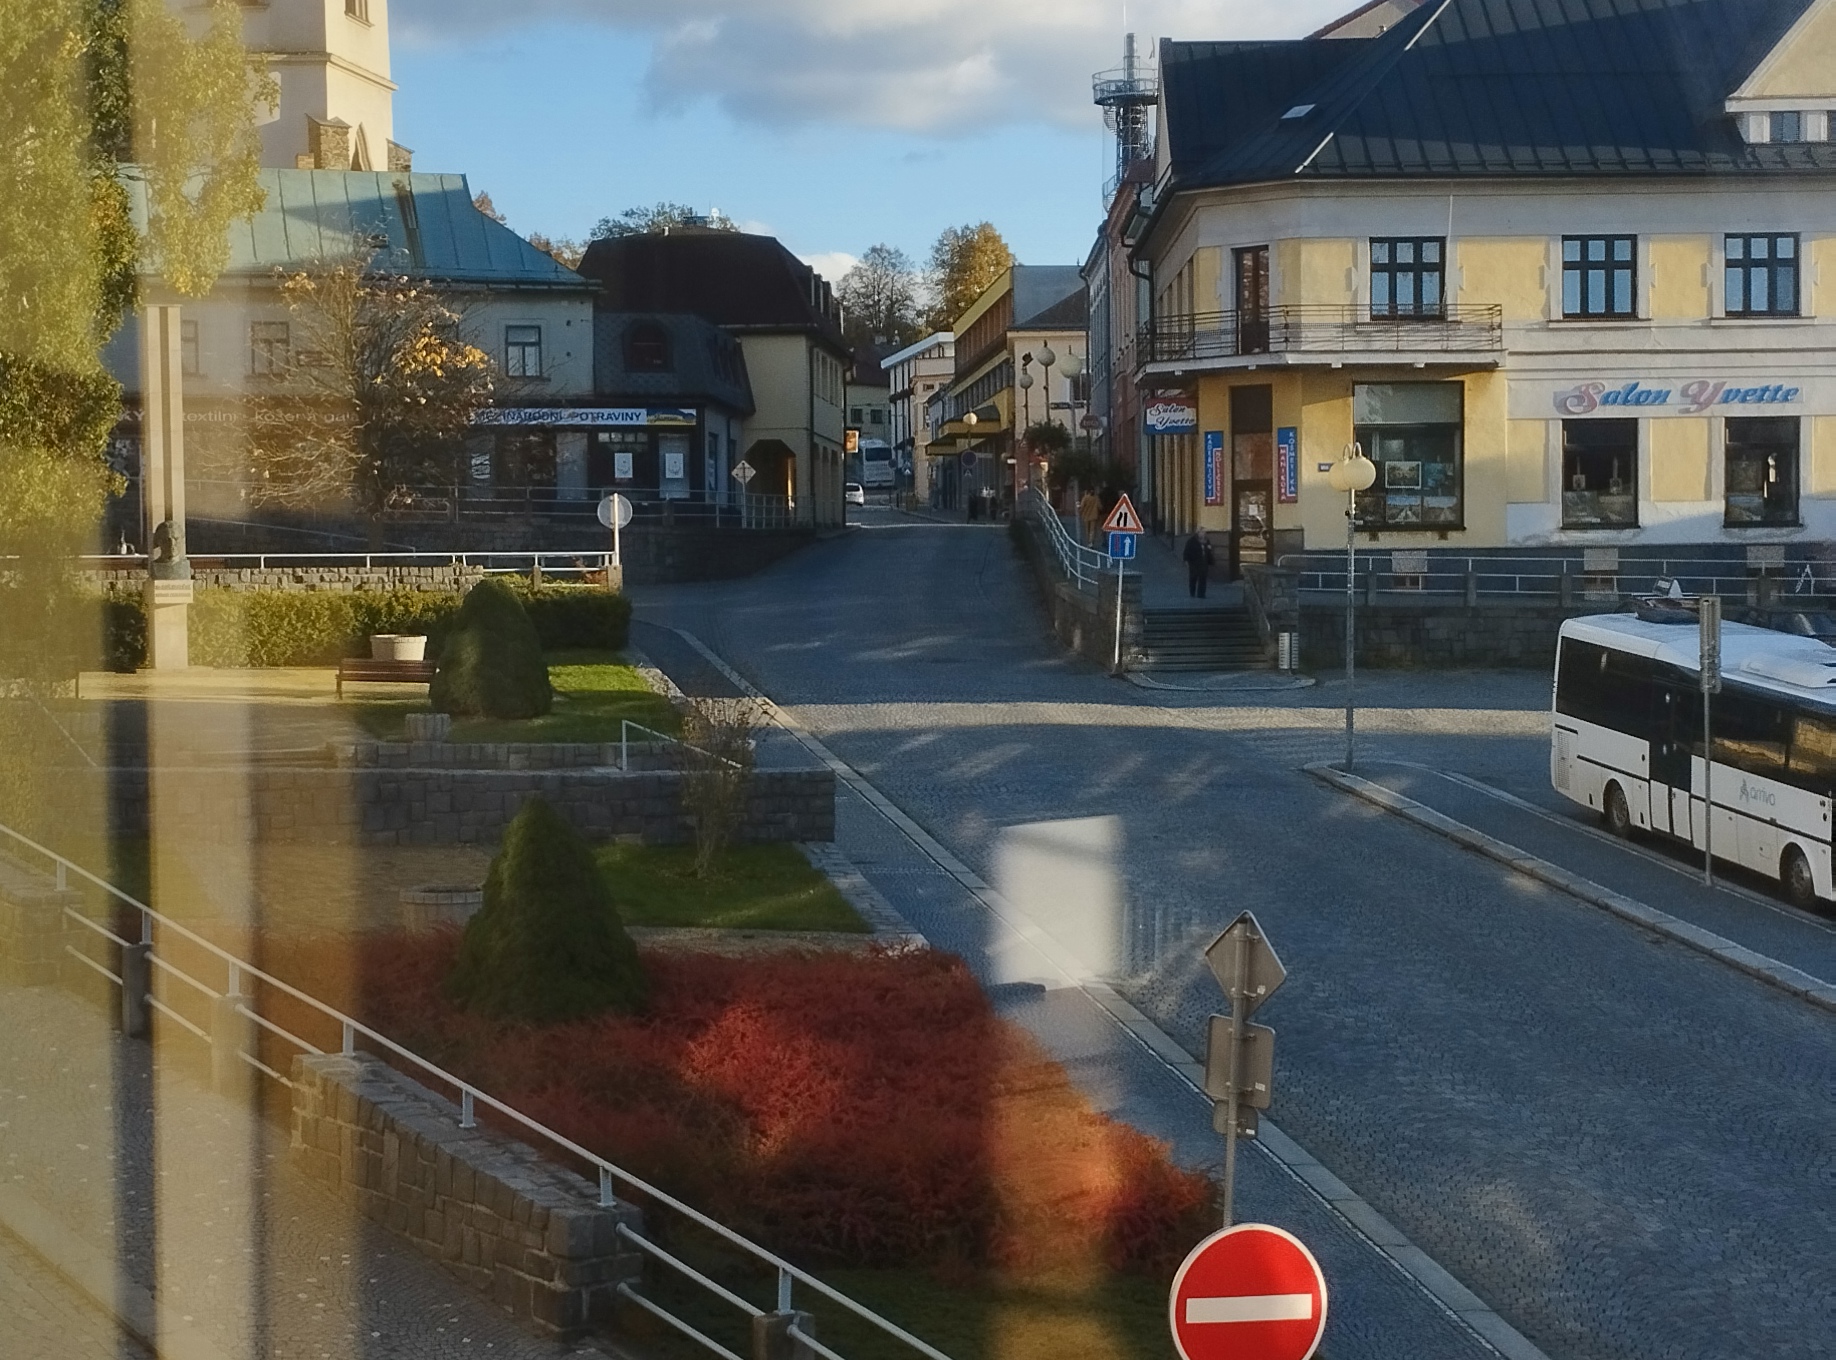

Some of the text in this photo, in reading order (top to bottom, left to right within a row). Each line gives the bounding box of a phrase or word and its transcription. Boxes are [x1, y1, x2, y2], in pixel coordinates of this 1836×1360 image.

[1557, 380, 1799, 415] Salon Yvette
[1149, 403, 1186, 416] Salon
[572, 411, 641, 422] POTRAVINY
[1156, 416, 1195, 428] Yvette
